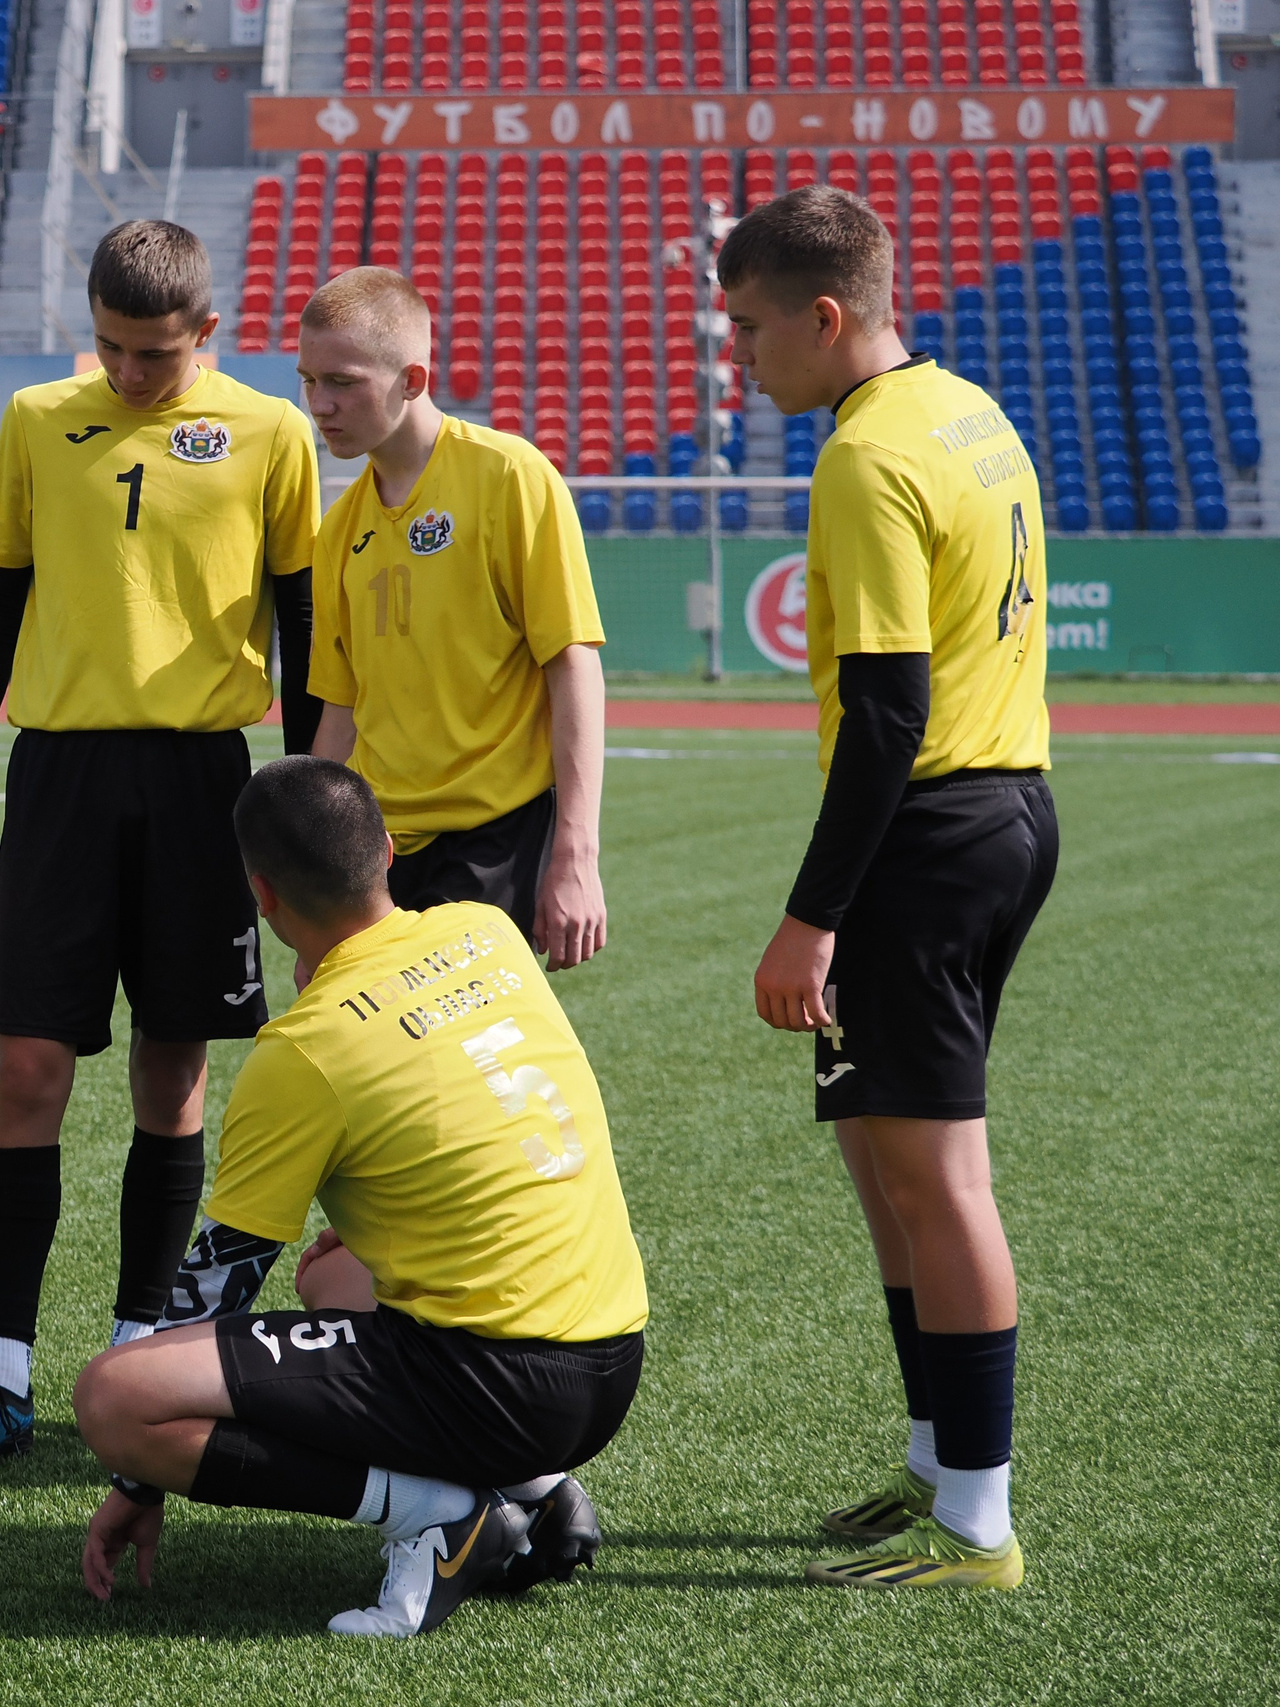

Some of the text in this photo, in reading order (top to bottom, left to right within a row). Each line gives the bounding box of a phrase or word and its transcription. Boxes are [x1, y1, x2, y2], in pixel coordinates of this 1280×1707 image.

[315, 99, 634, 144] ФУТБОЛ
[115, 463, 144, 531] 1
[368, 563, 413, 637] 10
[232, 926, 258, 980] 1
[398, 967, 523, 1040] ОБЛАСТЬ
[460, 1016, 586, 1181] 5
[289, 1318, 357, 1352] 5
